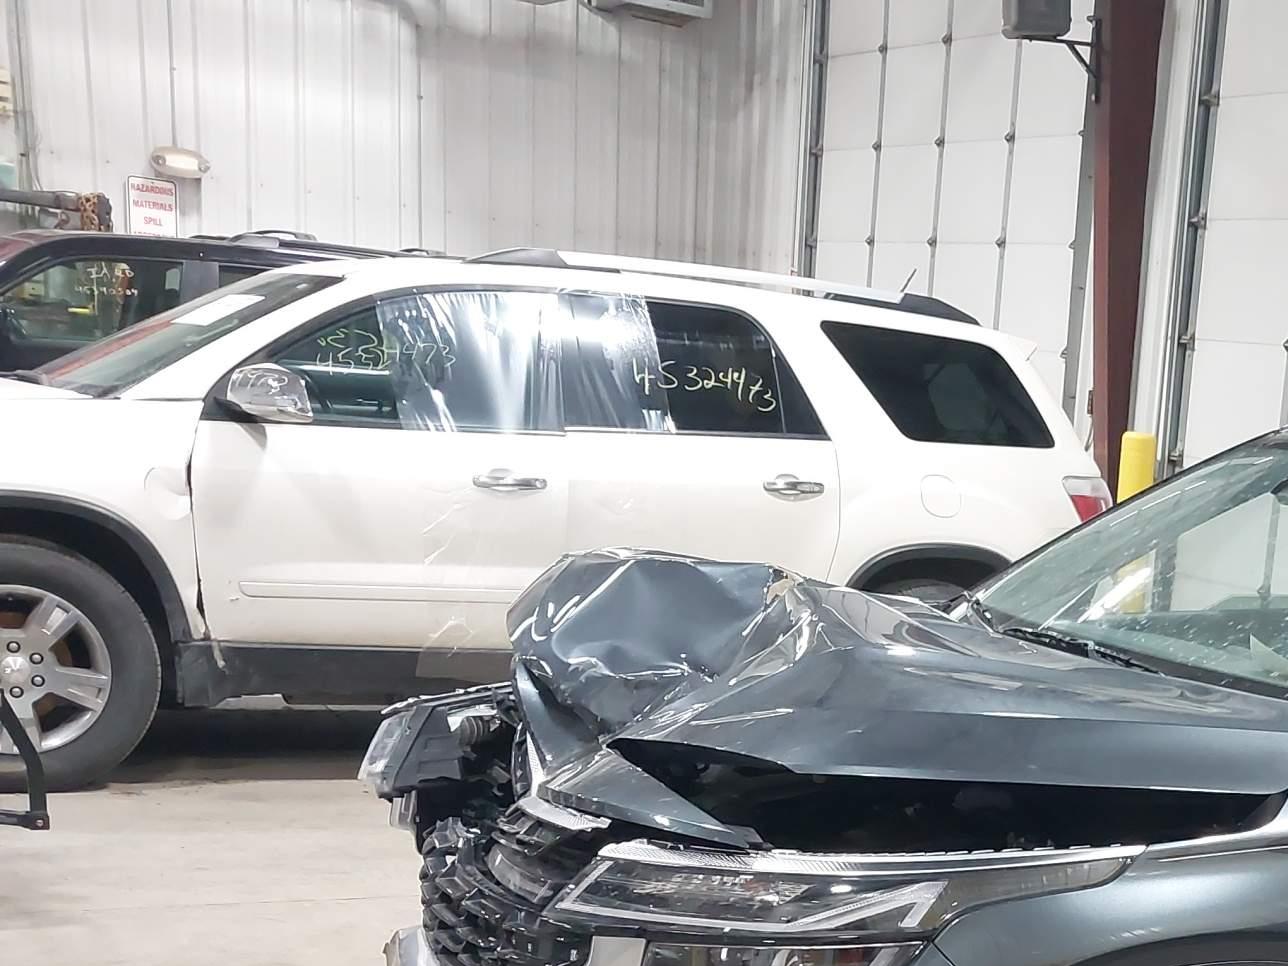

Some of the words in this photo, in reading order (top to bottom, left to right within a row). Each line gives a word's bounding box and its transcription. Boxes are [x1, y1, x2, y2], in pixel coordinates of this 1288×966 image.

[131, 183, 174, 196] HAZARDOUS
[132, 200, 173, 212] MATERIALS
[143, 216, 163, 227] SPILL
[632, 357, 777, 412] 45324473
